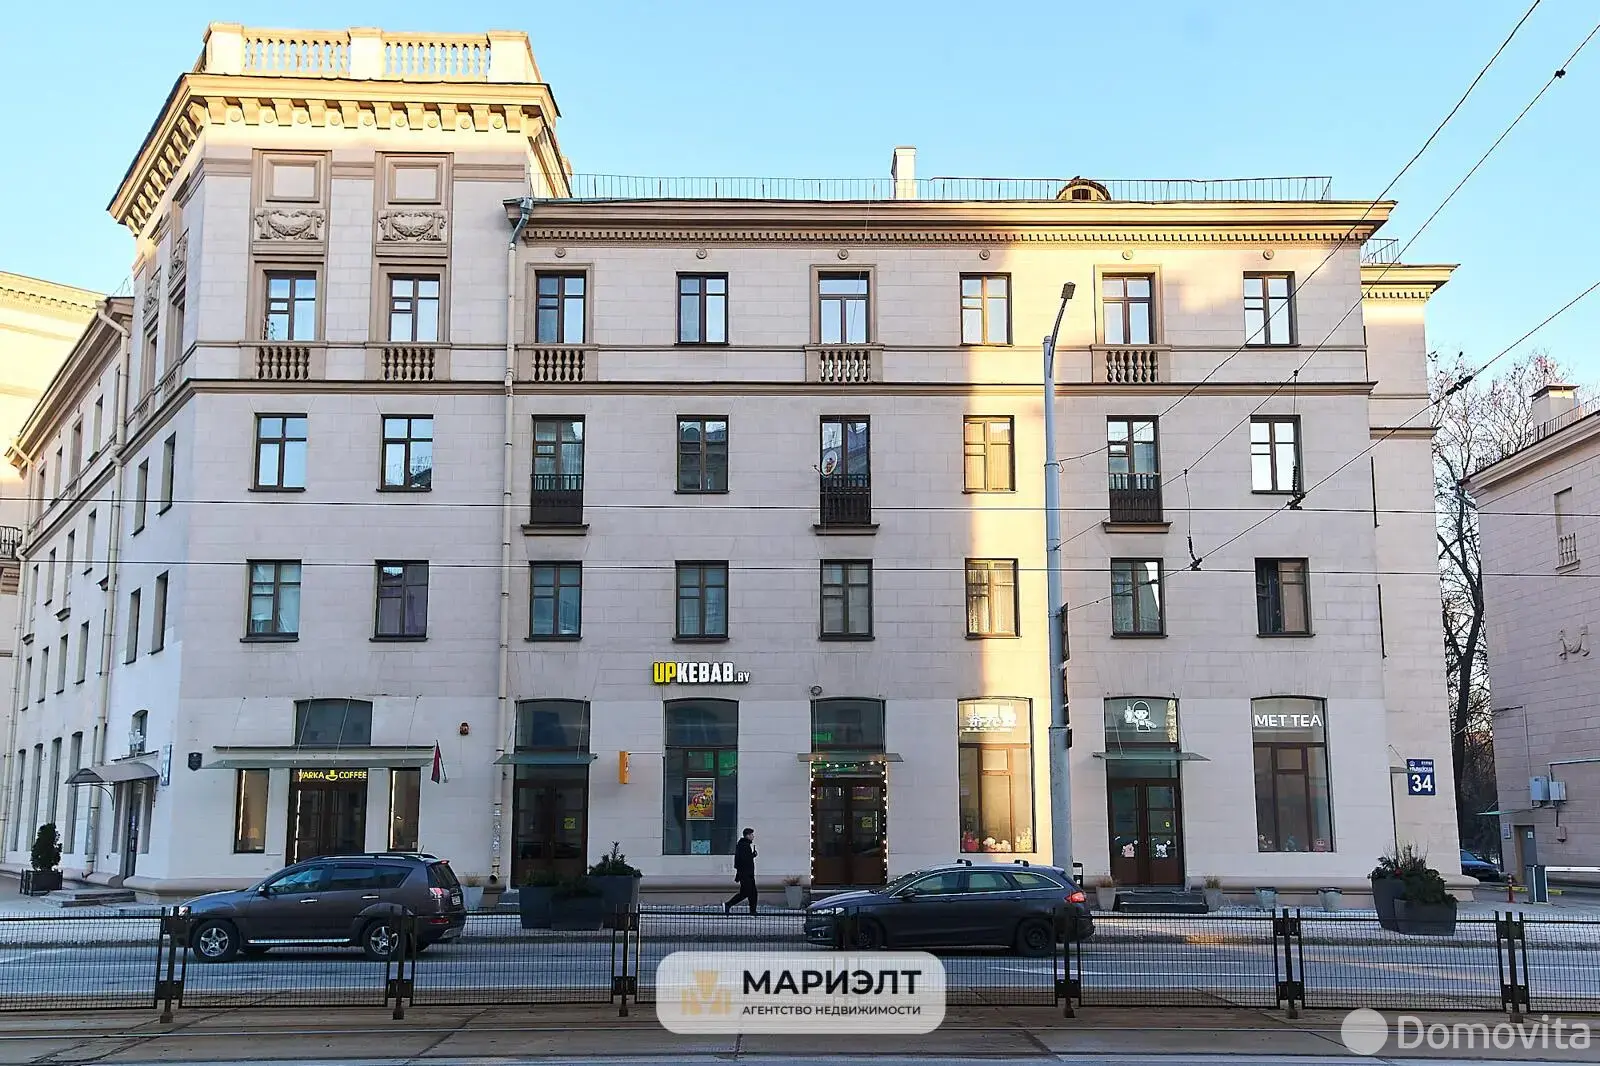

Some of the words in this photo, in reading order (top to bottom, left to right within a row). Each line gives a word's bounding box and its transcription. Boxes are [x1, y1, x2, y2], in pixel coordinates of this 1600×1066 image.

[1254, 714, 1287, 727] MET
[1290, 714, 1322, 727] TEA
[339, 771, 367, 779] COFFEE
[1411, 774, 1433, 792] 34
